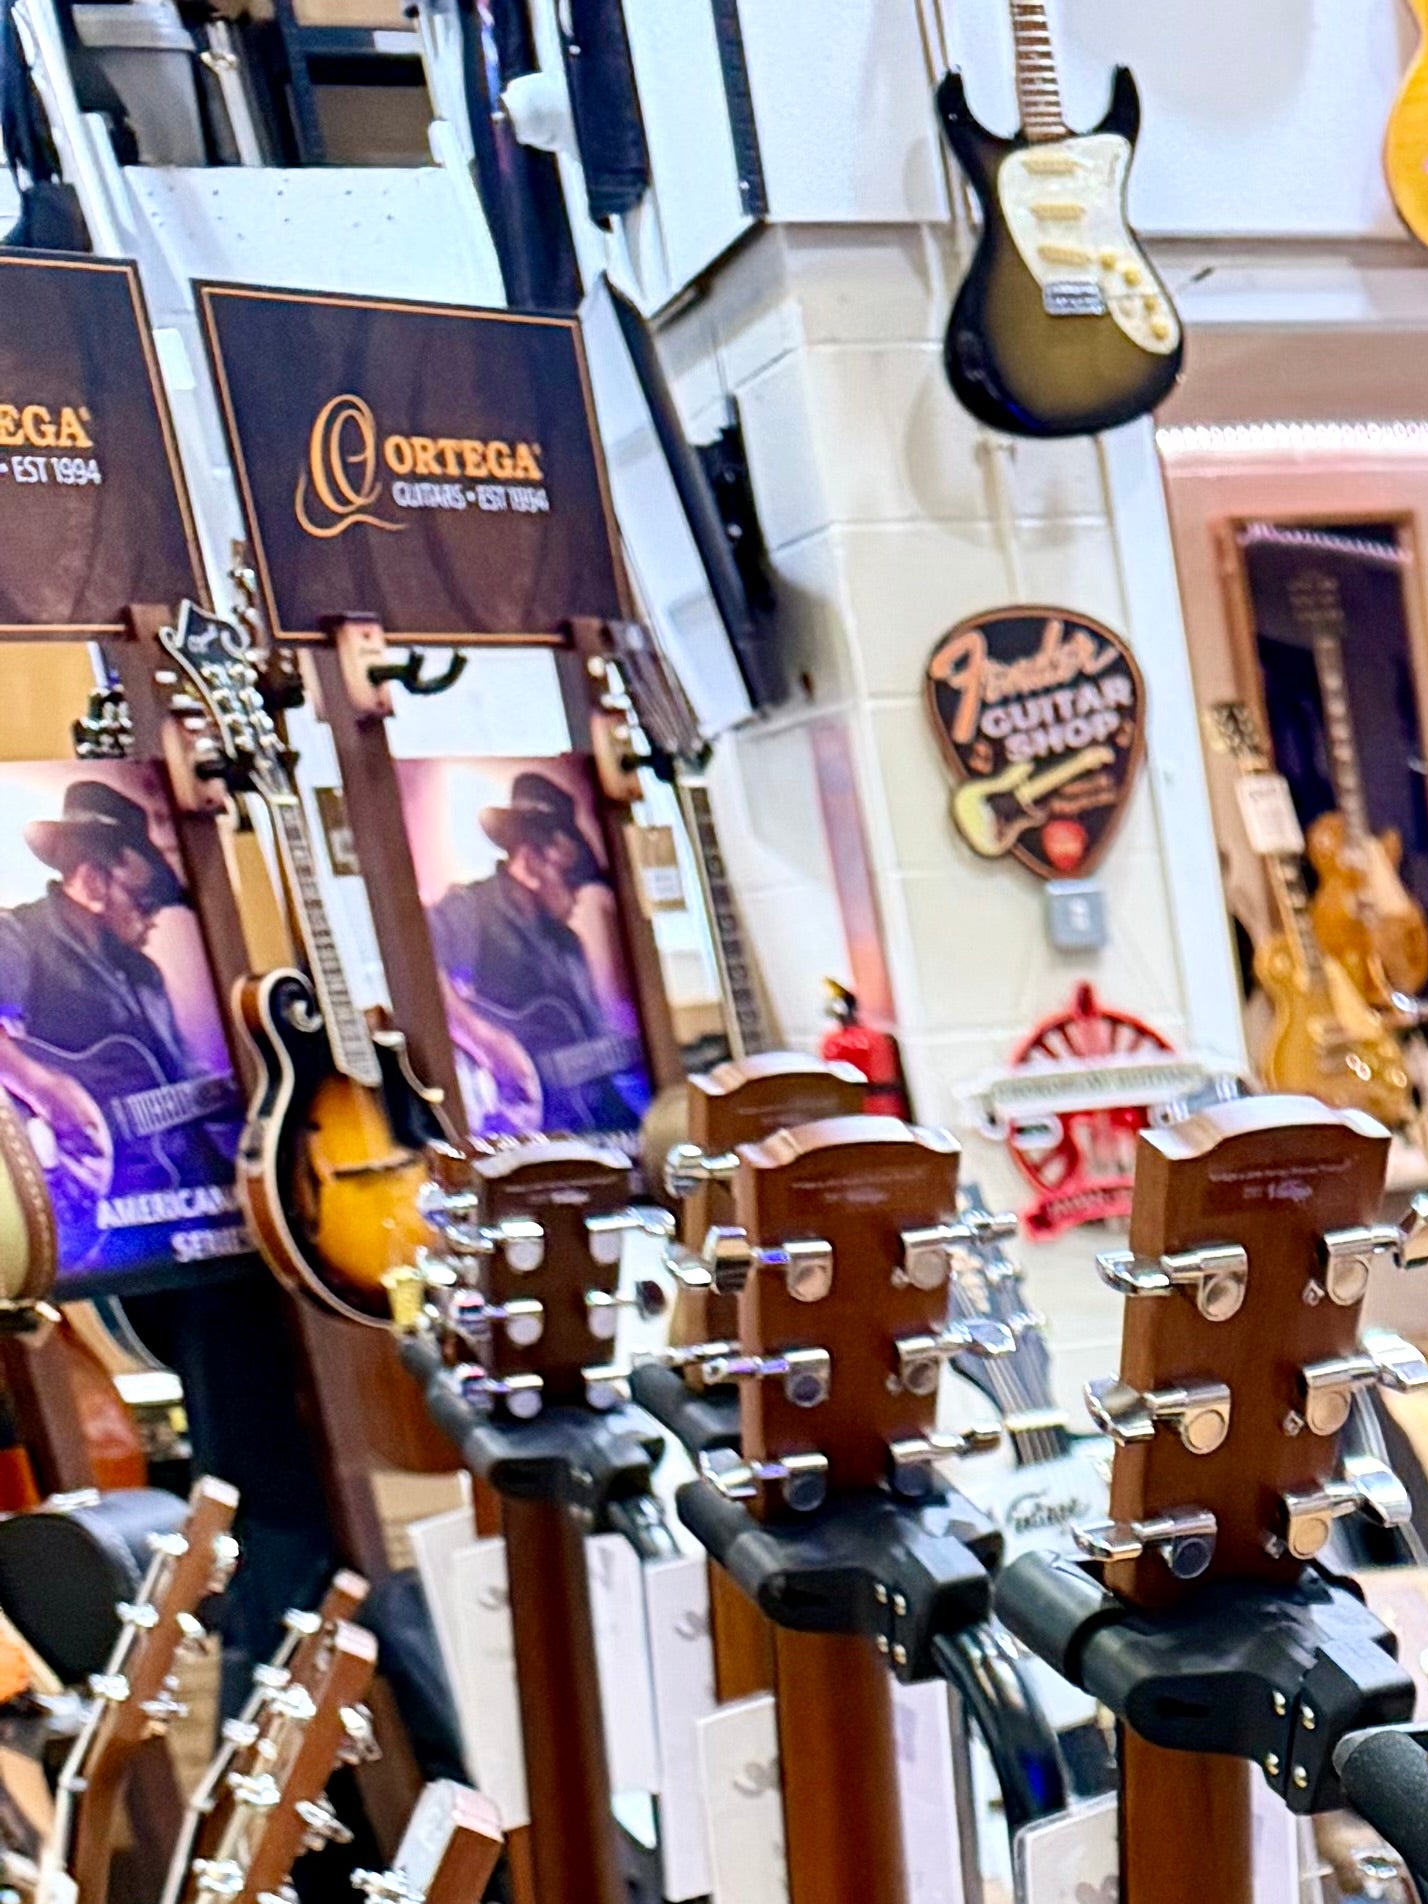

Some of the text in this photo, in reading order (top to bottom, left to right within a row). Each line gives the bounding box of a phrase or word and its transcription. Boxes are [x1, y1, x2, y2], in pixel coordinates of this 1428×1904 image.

[0, 406, 94, 449] EGA
[14, 457, 101, 485] EST 1994
[384, 435, 543, 481] ORTEGA
[929, 619, 1120, 743] Fender
[981, 675, 1132, 738] GUITAR
[1004, 710, 1121, 763] SHOP
[97, 1185, 238, 1230] AMERICAN
